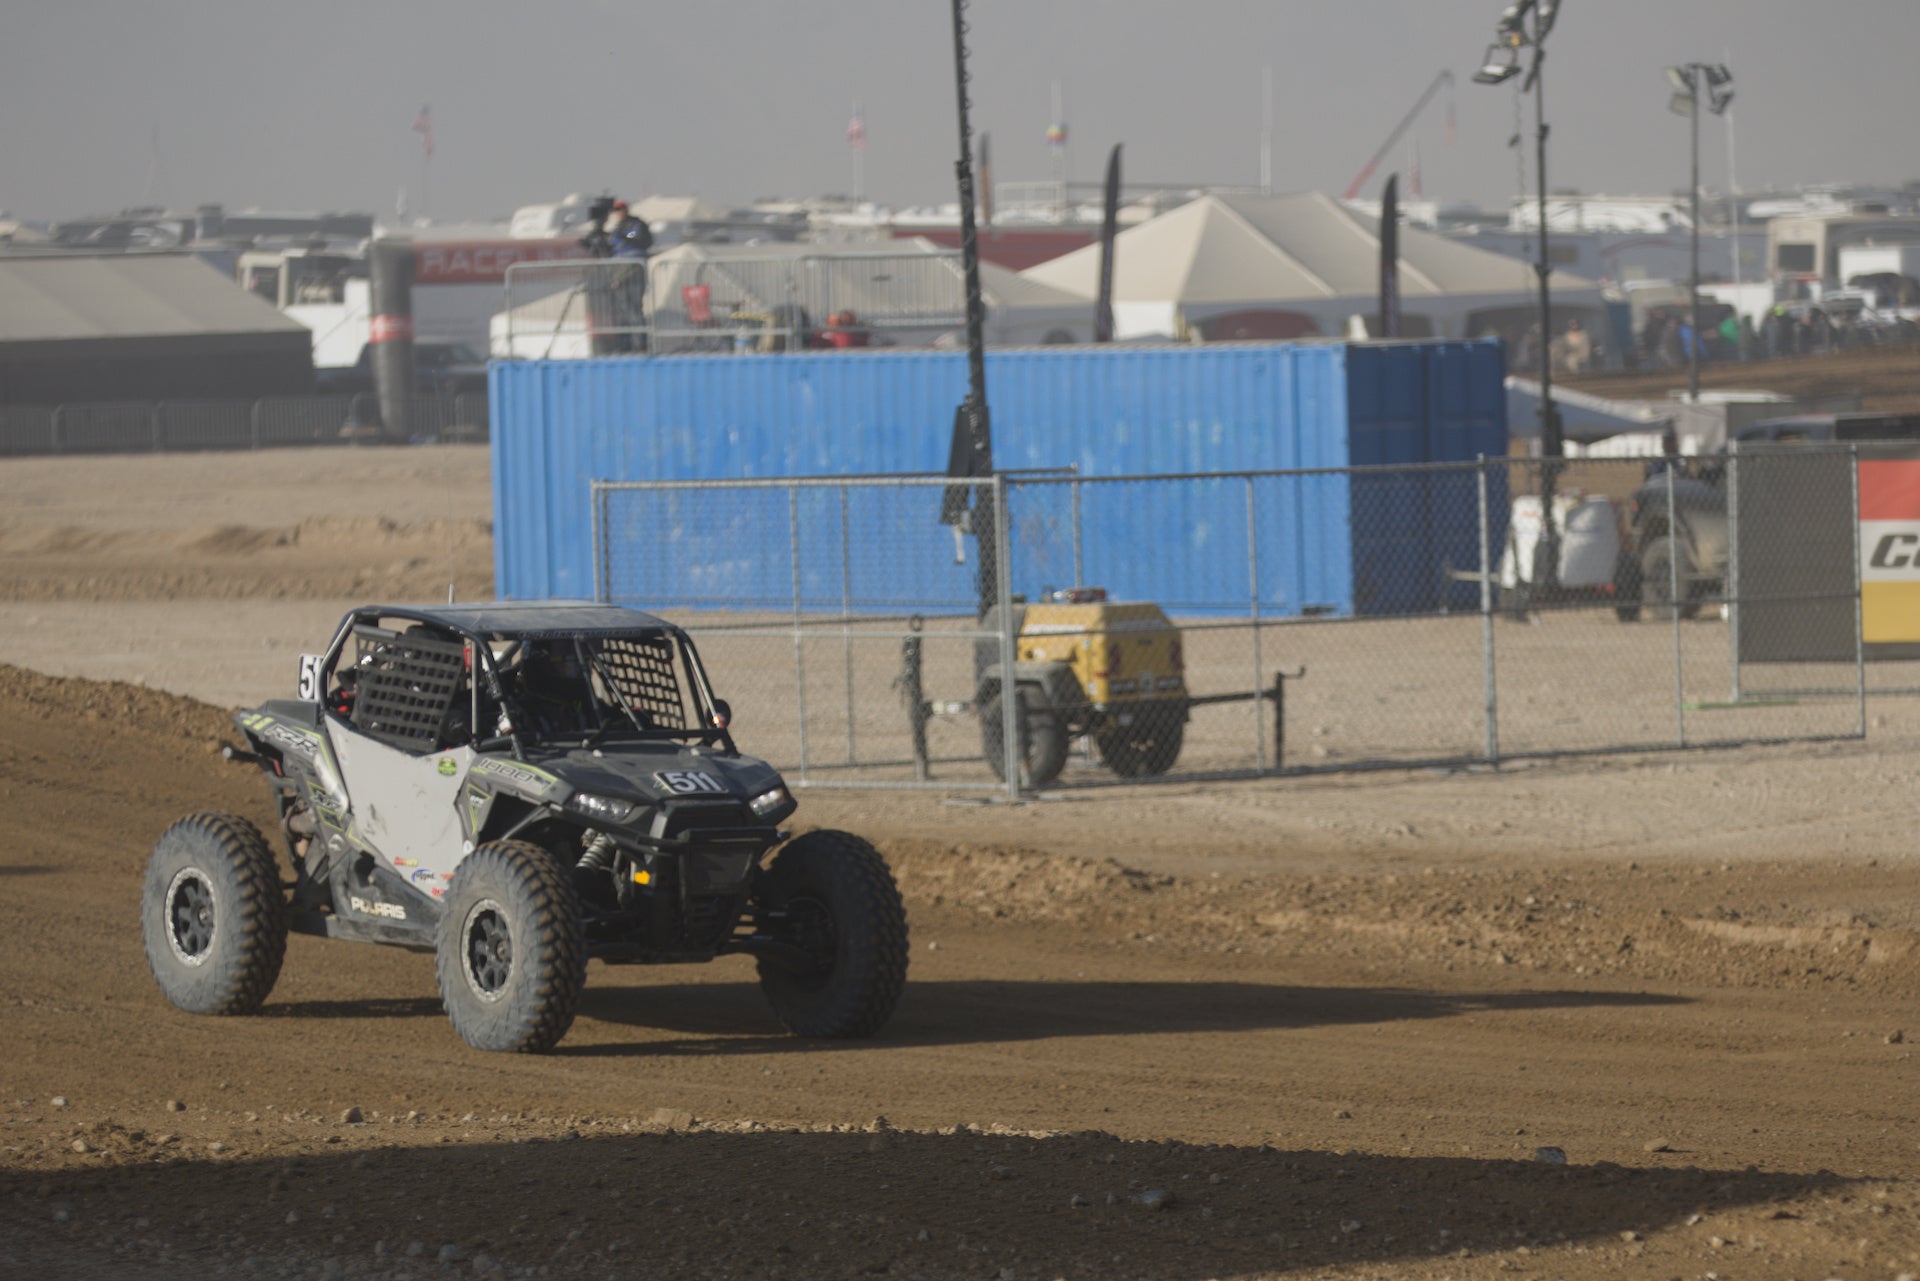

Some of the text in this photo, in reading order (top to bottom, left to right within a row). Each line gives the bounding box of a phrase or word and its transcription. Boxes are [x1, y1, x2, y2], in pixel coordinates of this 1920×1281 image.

[1869, 533, 1920, 568] C
[478, 757, 536, 784] 1000
[663, 771, 723, 792] 511
[350, 896, 406, 920] POLARIS
